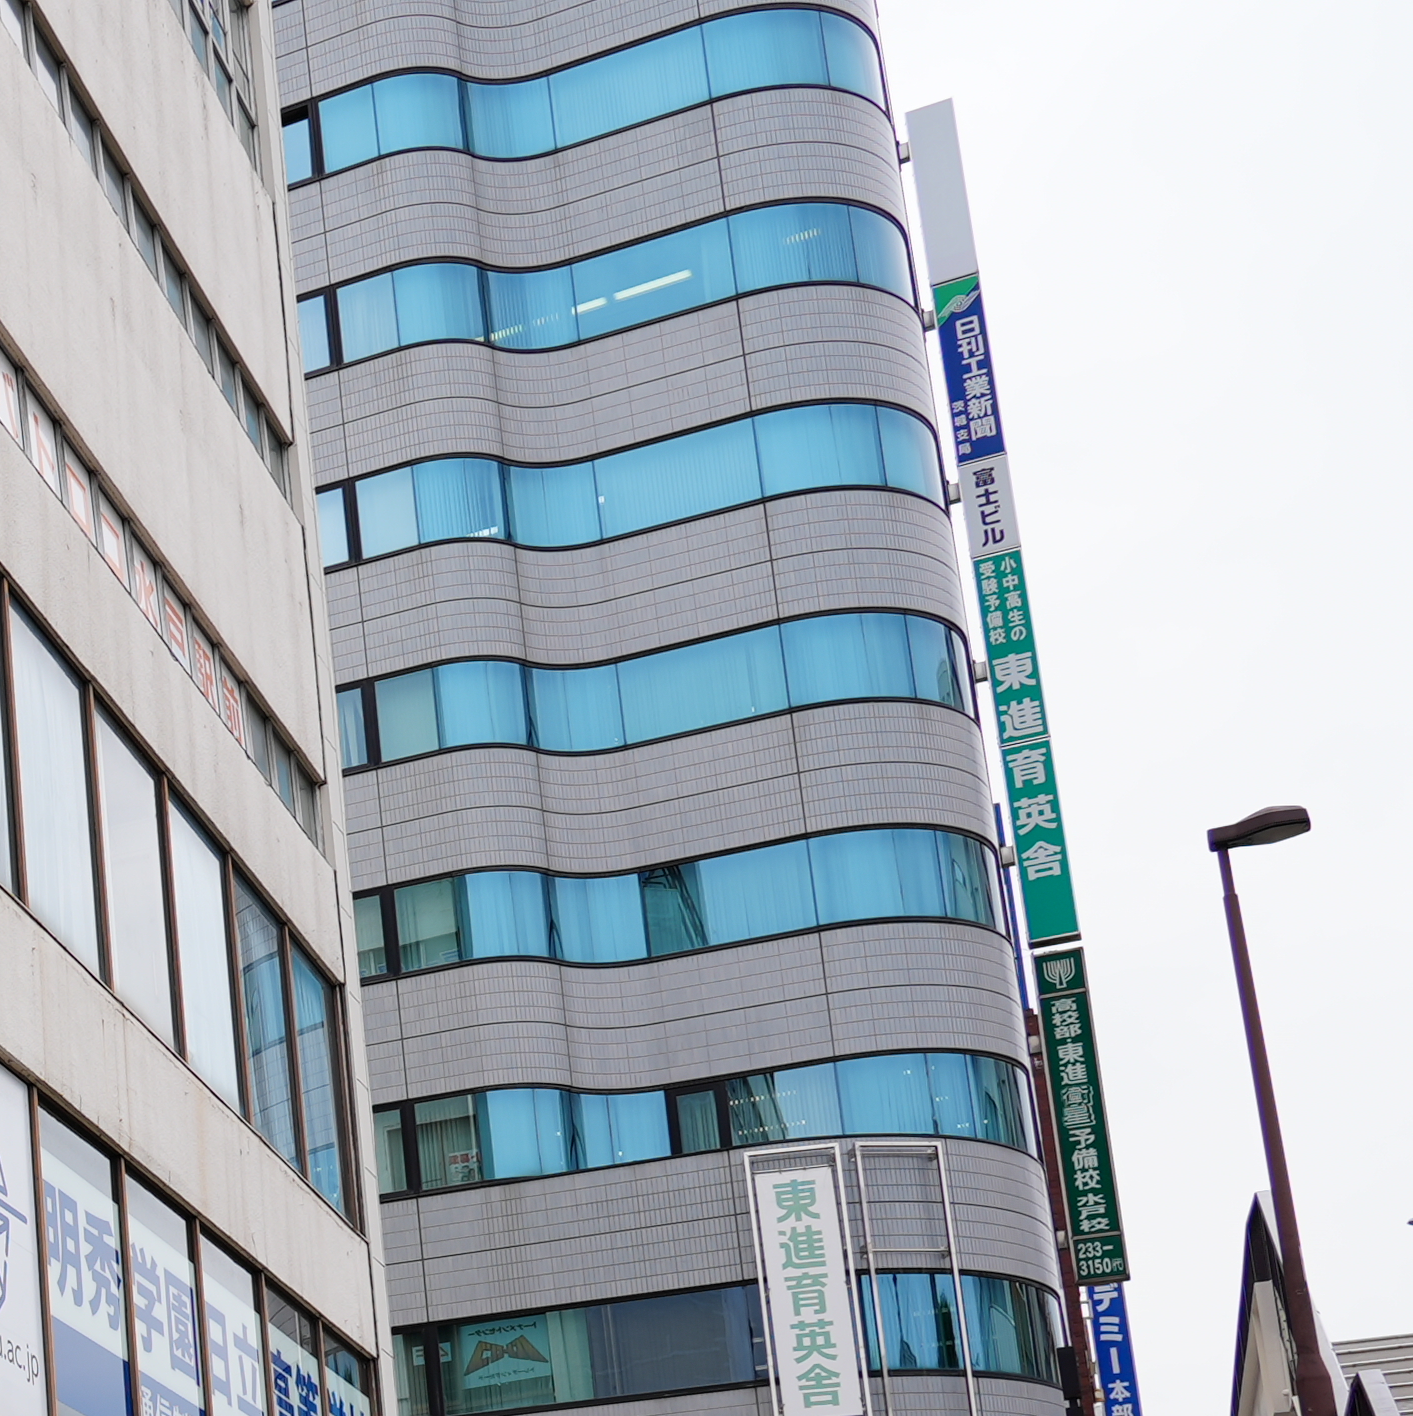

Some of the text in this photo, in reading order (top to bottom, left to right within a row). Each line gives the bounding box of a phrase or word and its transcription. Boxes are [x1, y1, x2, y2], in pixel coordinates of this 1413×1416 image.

[954, 315, 996, 440] 日刊工業新聞
[952, 399, 972, 456] 茨城支局
[972, 466, 1005, 548] 富士ビル
[979, 562, 1006, 645] 受験予備校
[1000, 556, 1026, 642] 小中高生の
[992, 651, 1063, 882] 東進育英舎
[1050, 997, 1110, 1232] 高校部・東進衛星予備校 水戸校
[772, 1178, 841, 1408] 東進育英舎
[1079, 1258, 1112, 1276] 3150
